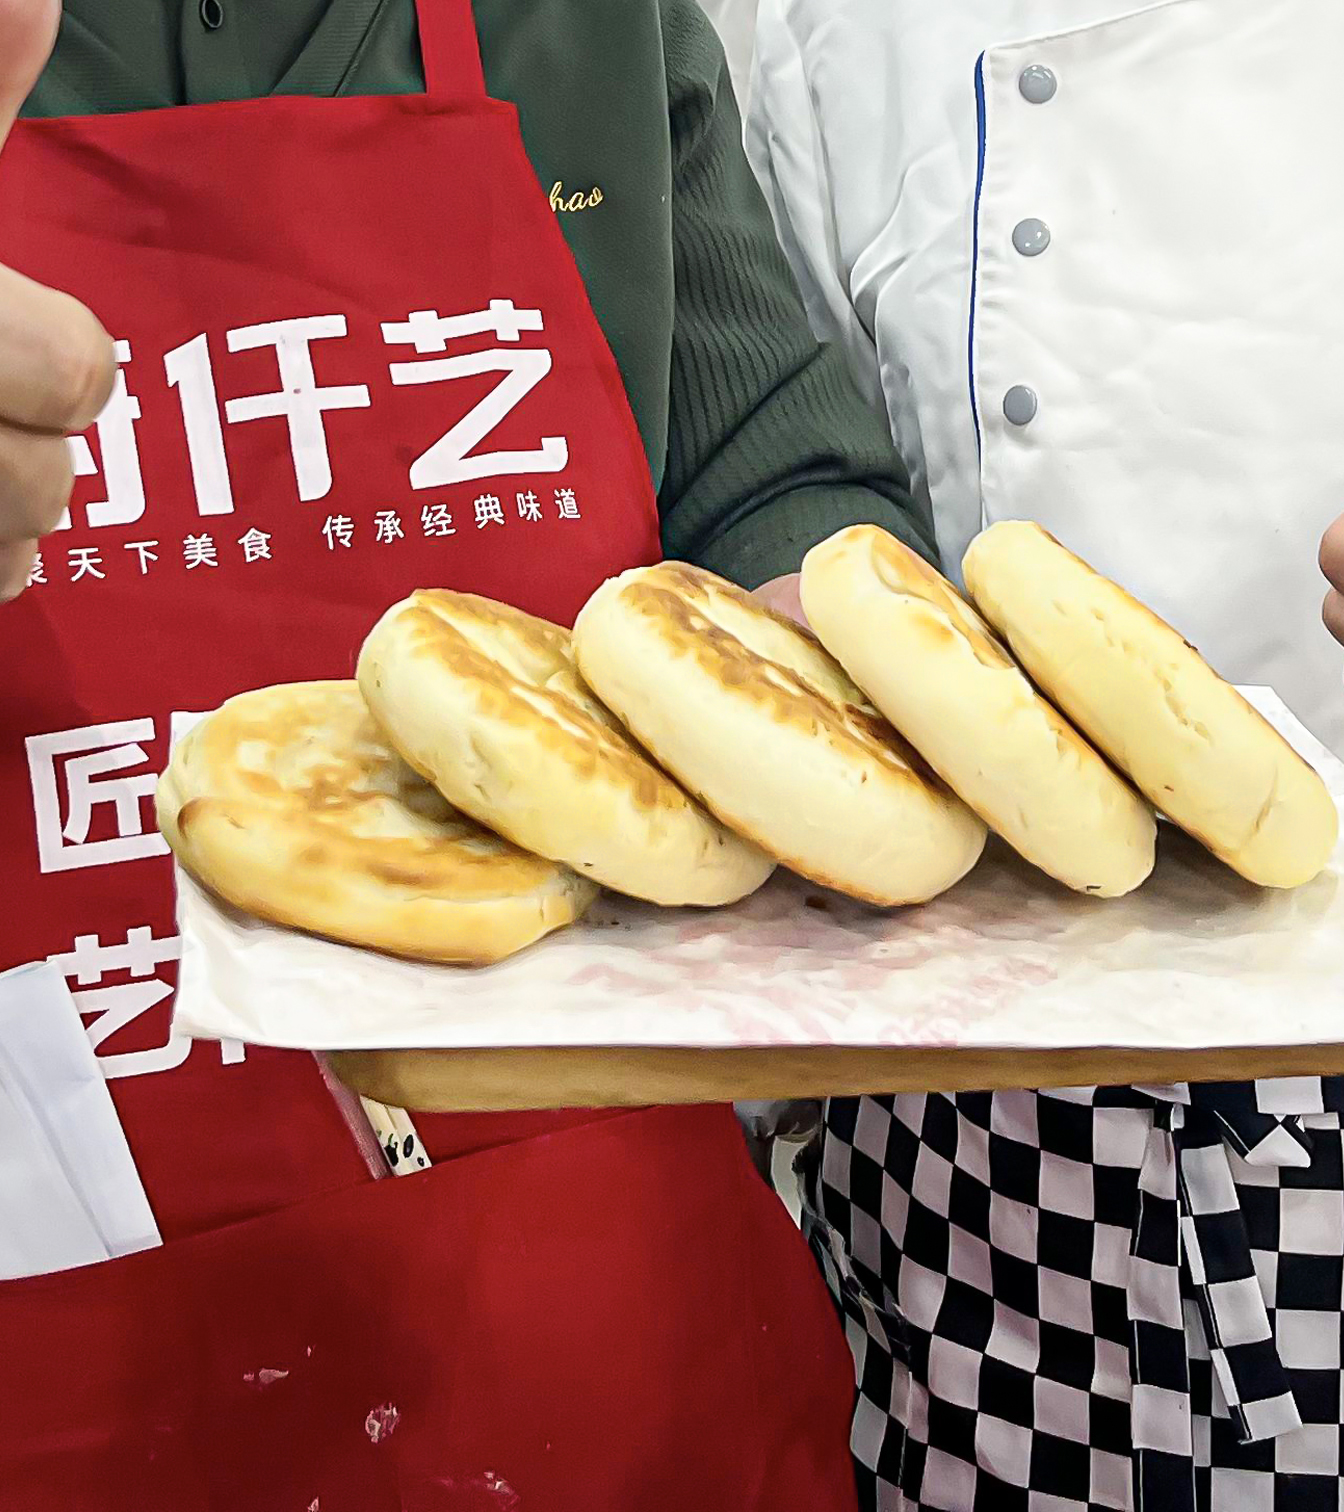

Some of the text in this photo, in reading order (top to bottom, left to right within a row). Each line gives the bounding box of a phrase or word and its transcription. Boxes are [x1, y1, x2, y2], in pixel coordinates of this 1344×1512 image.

[321, 487, 582, 551] 传承经典味道
[46, 926, 246, 1080] 艺
